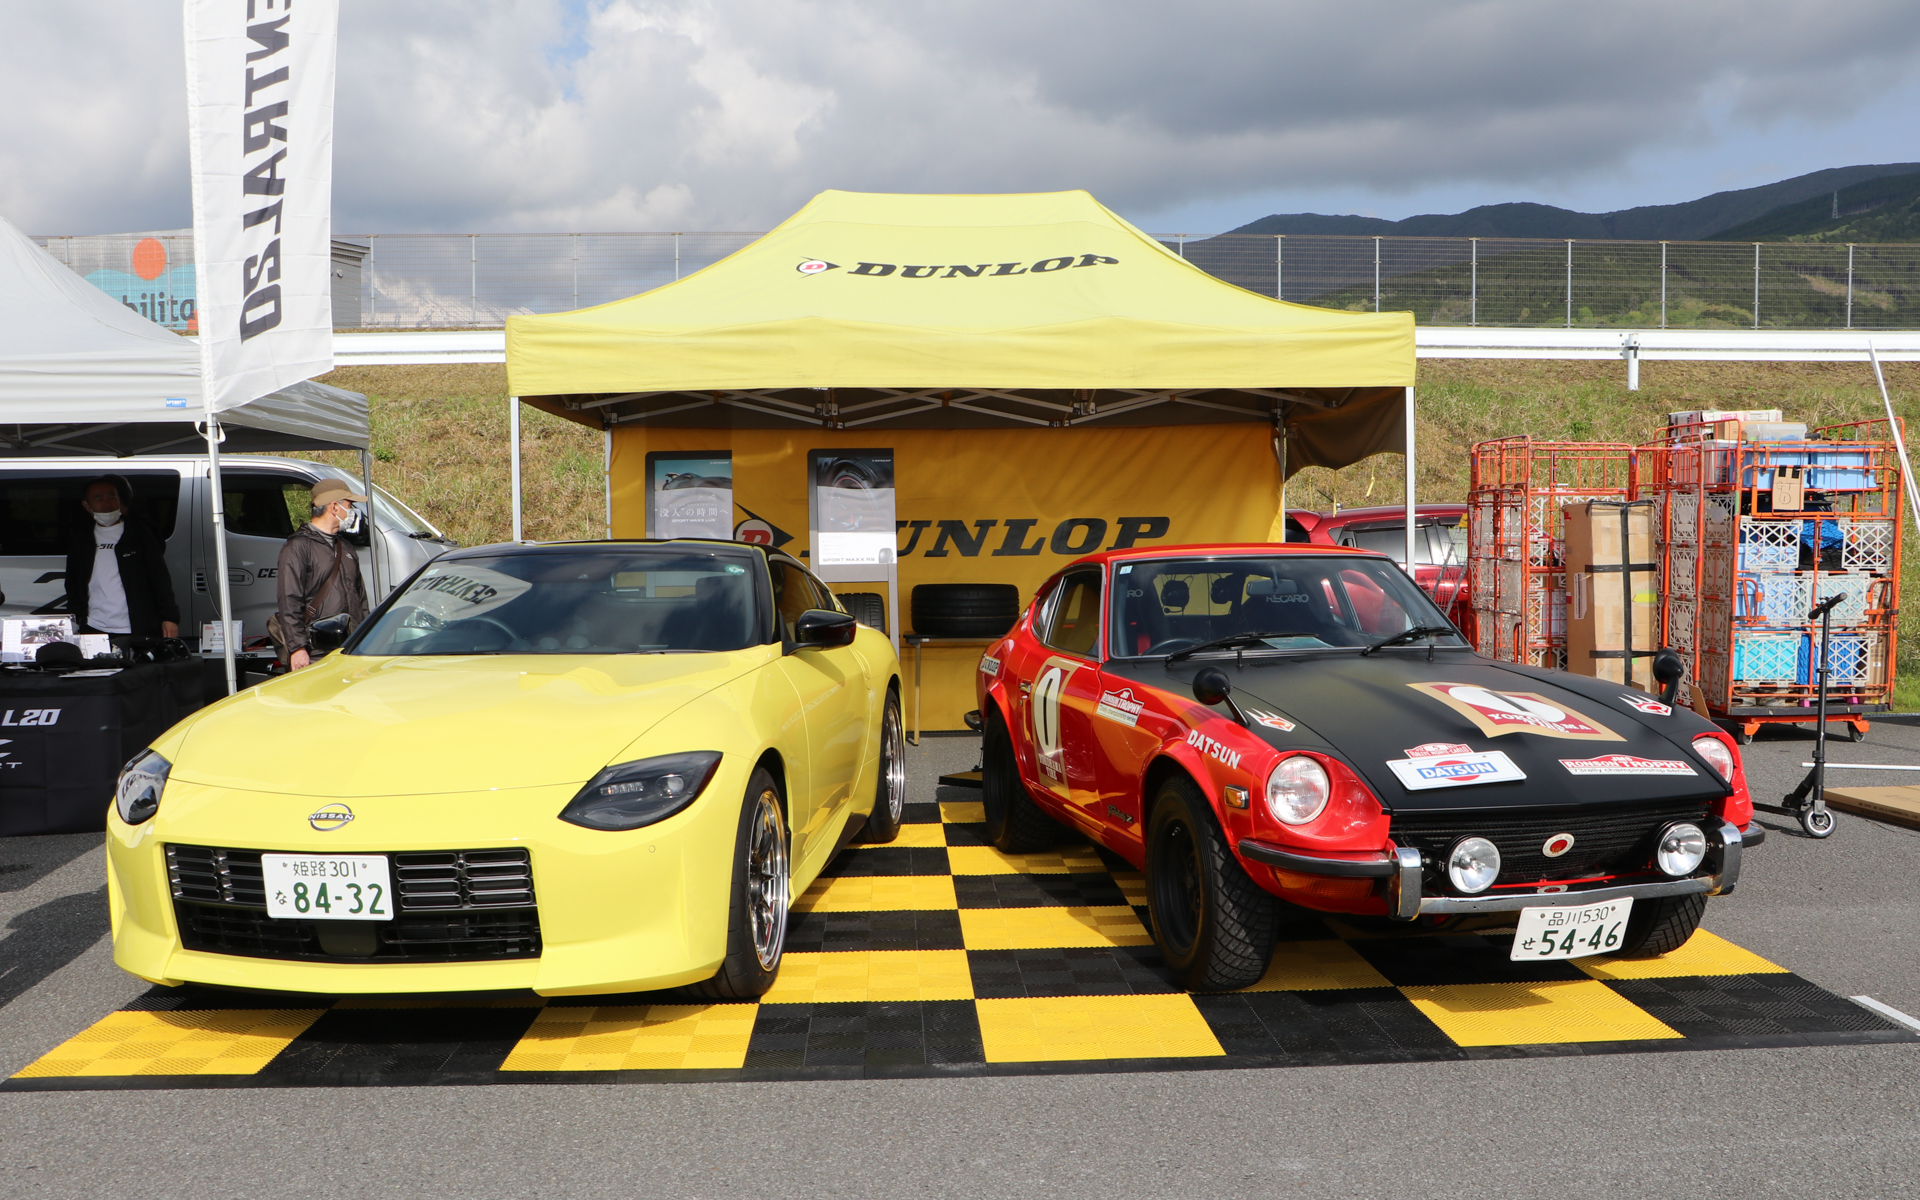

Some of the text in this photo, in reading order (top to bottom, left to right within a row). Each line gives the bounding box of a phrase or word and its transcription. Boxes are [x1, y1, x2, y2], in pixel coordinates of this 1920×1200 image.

[847, 253, 1120, 278] DUNLOP
[896, 516, 1171, 557] UNLOP
[257, 567, 279, 578] CE
[1126, 589, 1144, 598] RO
[1266, 593, 1310, 604] RECARO
[1117, 698, 1142, 715] TROPHY
[0, 708, 62, 727] L20
[1186, 728, 1242, 770] DATSUN
[1420, 762, 1495, 779] DATSUN
[1564, 760, 1690, 769] RONSON TROPHY
[308, 813, 354, 821] NISSAN
[292, 860, 358, 878] 姫路301
[274, 881, 386, 915] な 84-32
[1547, 906, 1610, 927] 品川530
[1521, 920, 1622, 956] せ 54-46
